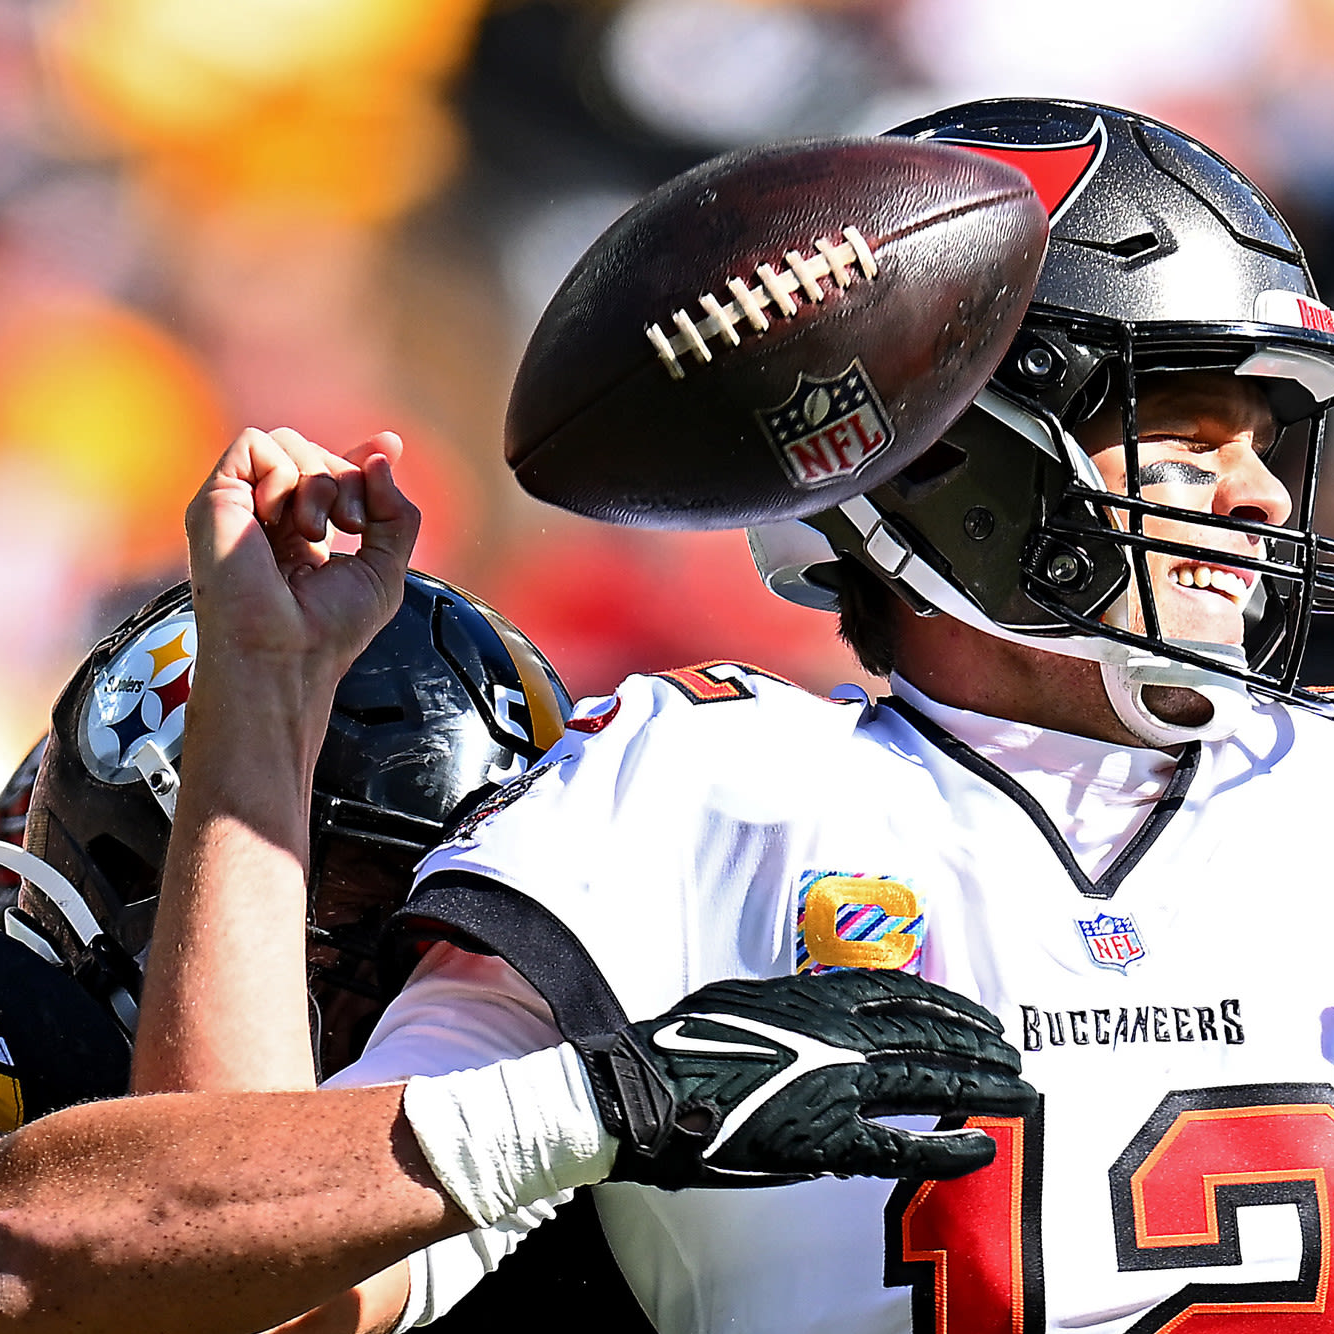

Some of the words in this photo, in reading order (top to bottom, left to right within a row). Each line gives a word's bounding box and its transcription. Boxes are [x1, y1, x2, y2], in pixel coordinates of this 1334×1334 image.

[790, 413, 885, 479] NFL
[804, 876, 917, 970] C
[1093, 933, 1141, 960] NFL
[1019, 999, 1246, 1052] BUCCANEERS
